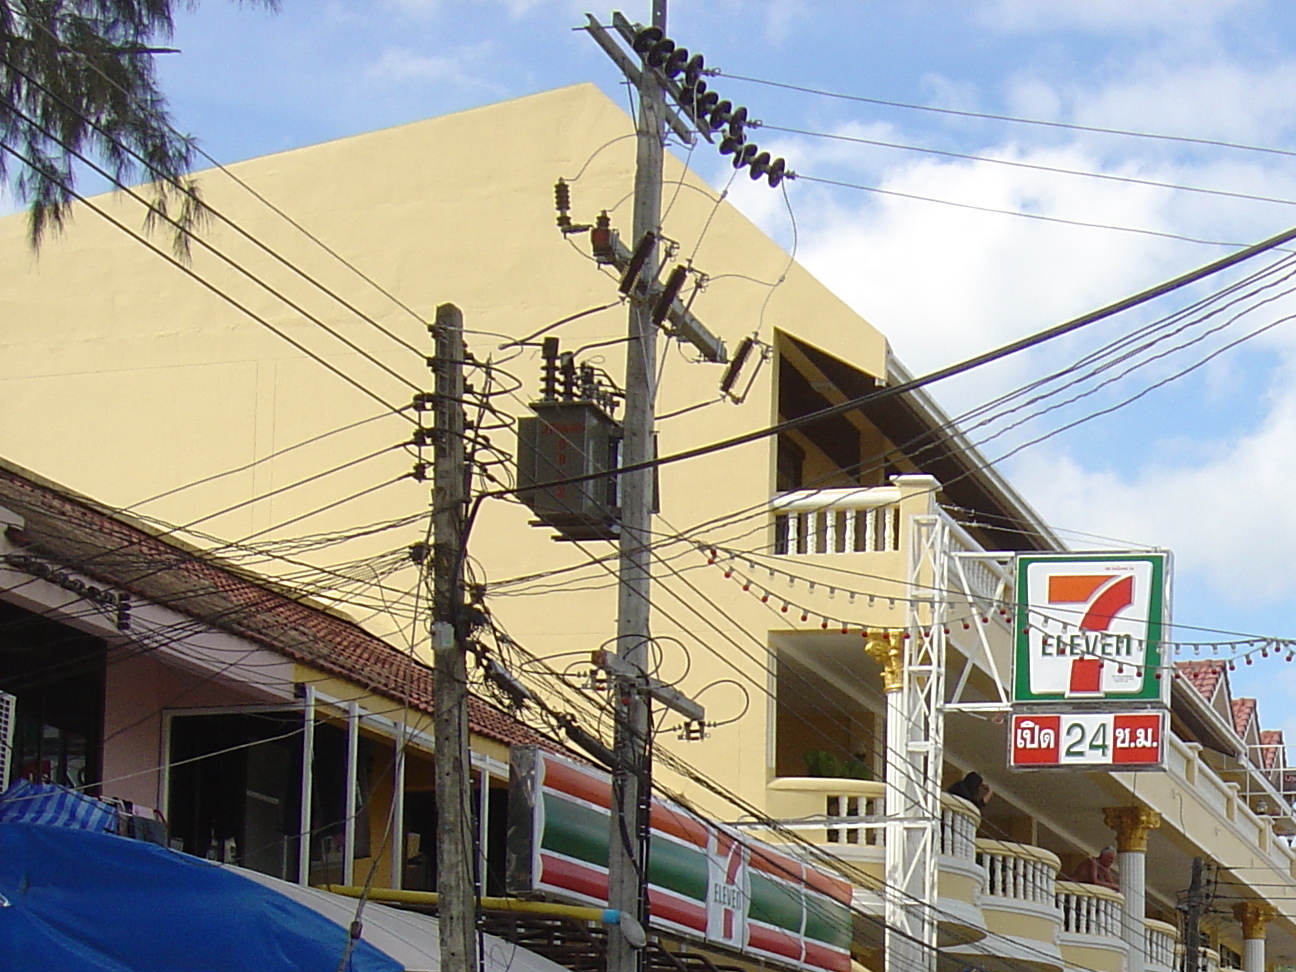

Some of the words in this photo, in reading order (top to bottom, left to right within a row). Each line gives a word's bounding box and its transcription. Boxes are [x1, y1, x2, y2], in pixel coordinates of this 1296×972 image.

[1047, 574, 1132, 692] 7
[1016, 720, 1055, 748] เปิด
[1065, 722, 1108, 757] 24
[1115, 728, 1158, 748] ช.ม.
